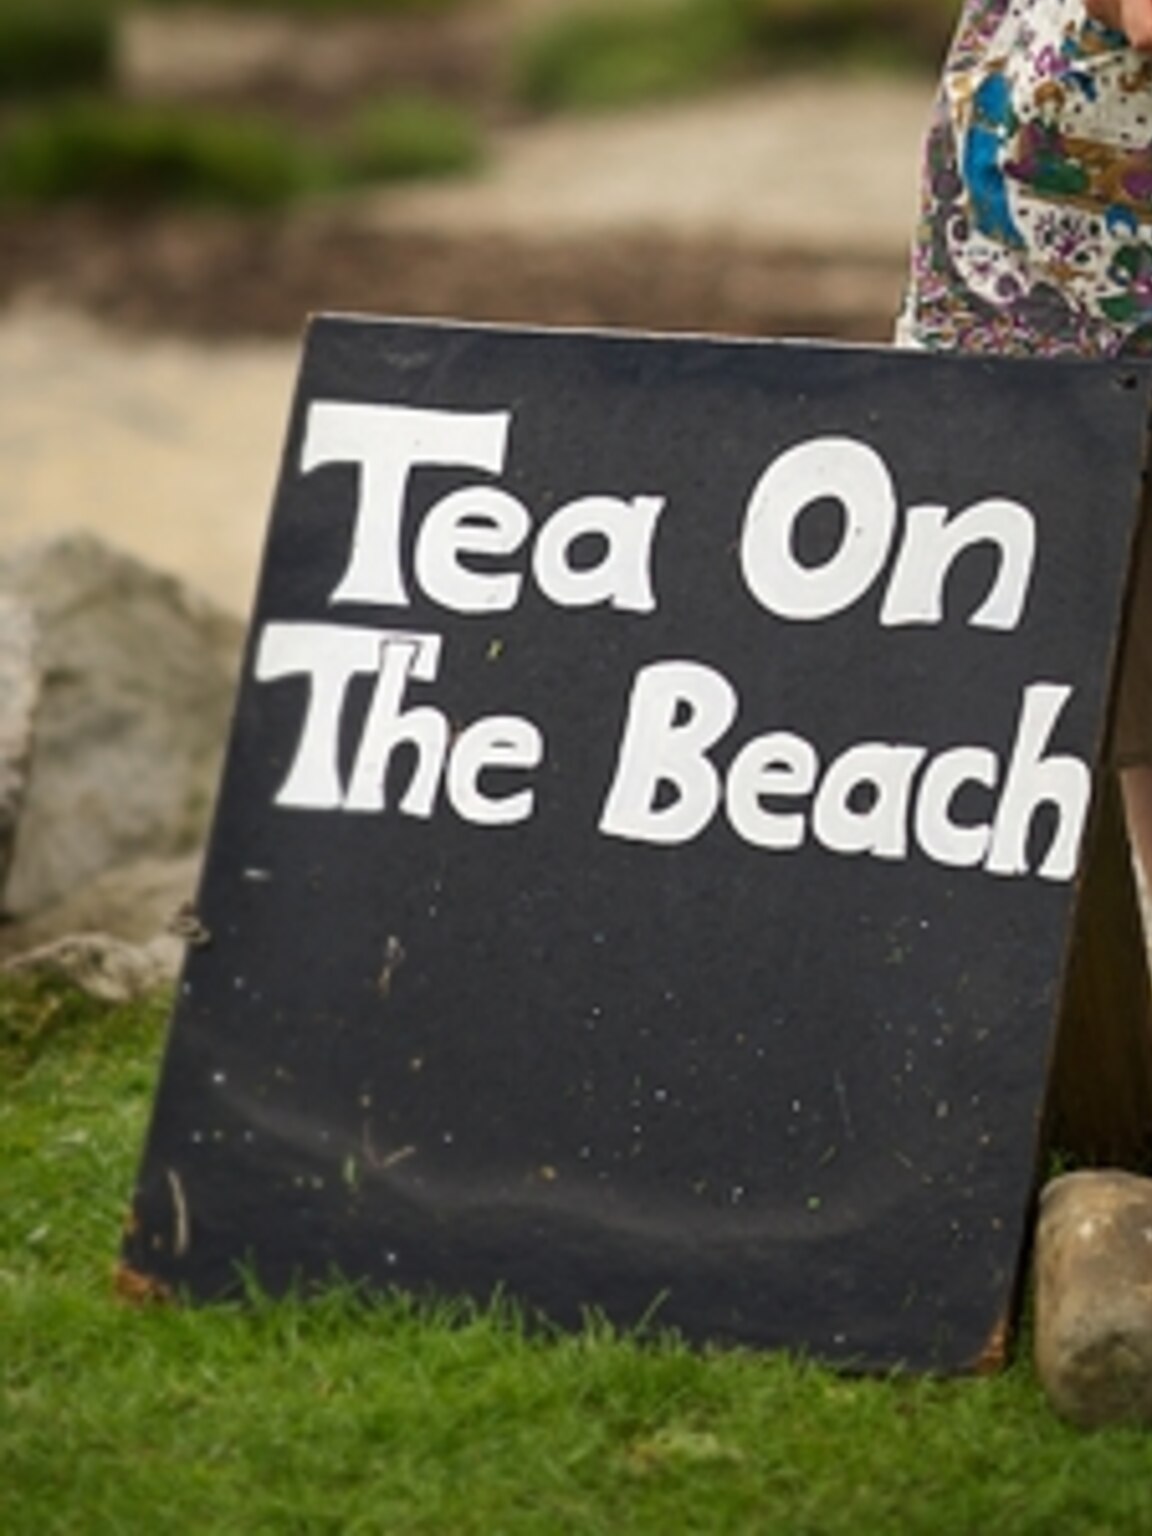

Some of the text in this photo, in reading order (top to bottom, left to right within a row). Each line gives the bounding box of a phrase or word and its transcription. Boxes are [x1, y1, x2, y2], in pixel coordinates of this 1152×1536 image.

[299, 400, 1038, 631] Tea On
[254, 620, 1093, 881] The Beach
